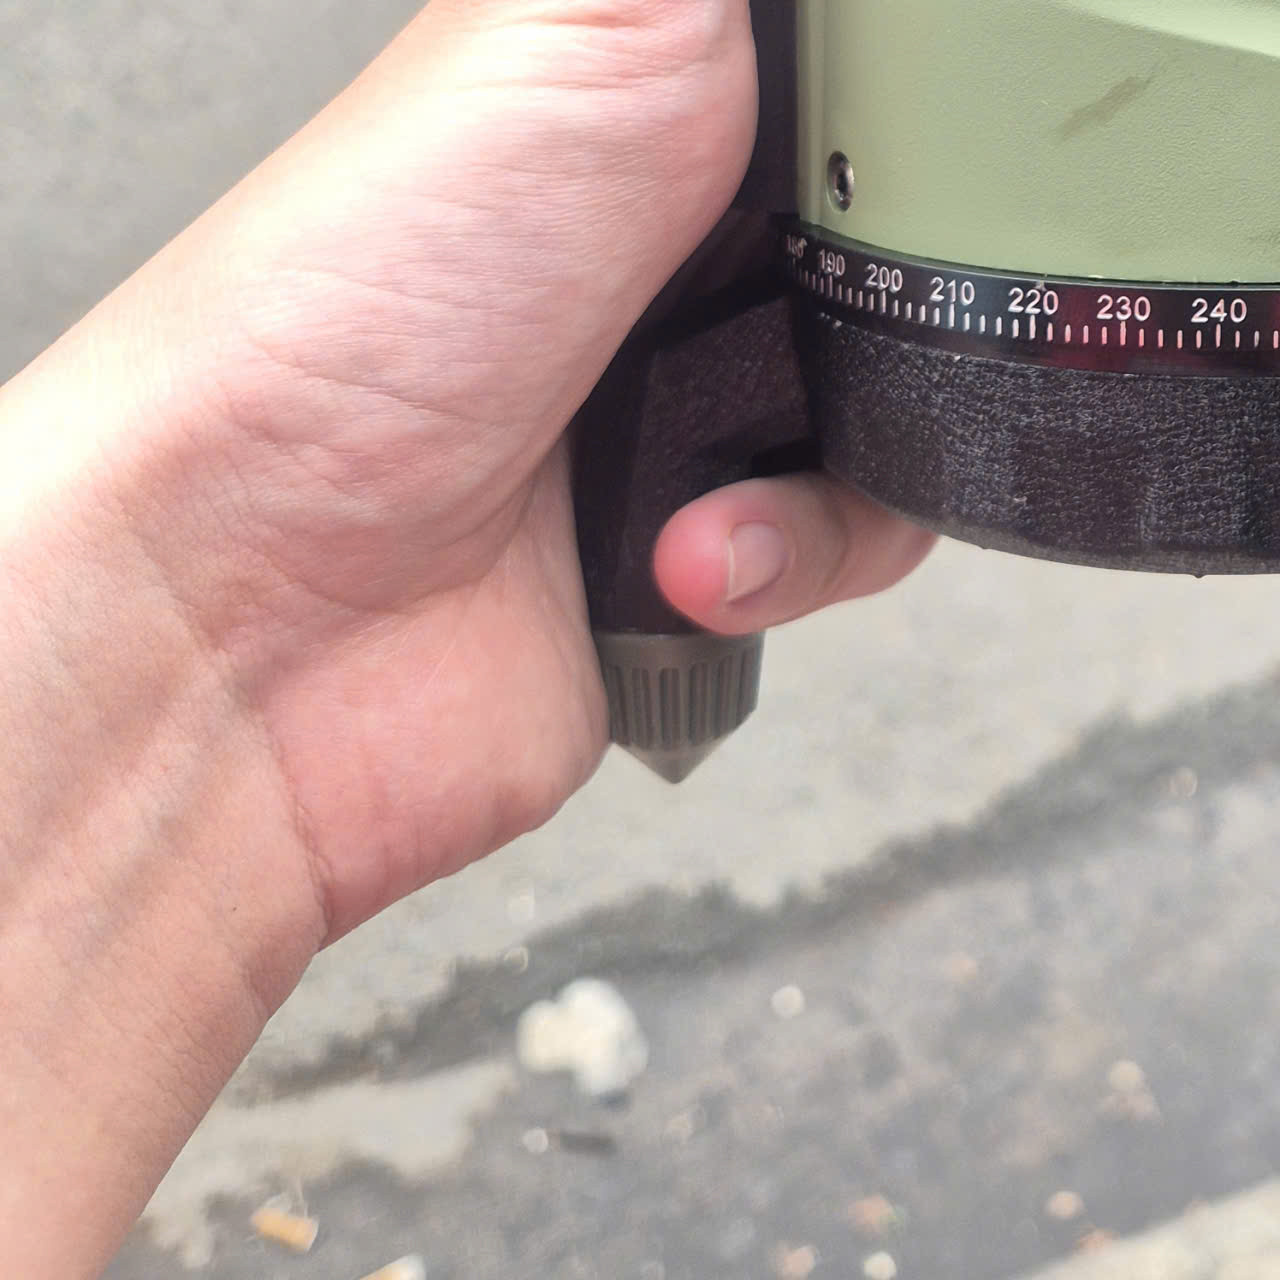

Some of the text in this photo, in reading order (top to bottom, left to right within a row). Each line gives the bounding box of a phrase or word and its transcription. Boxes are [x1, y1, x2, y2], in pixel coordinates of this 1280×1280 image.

[818, 248, 846, 278] 190
[865, 263, 904, 294] 200
[929, 276, 976, 306] 210
[1007, 287, 1059, 316] 220
[1096, 293, 1151, 322] 230
[1190, 297, 1248, 324] 240
